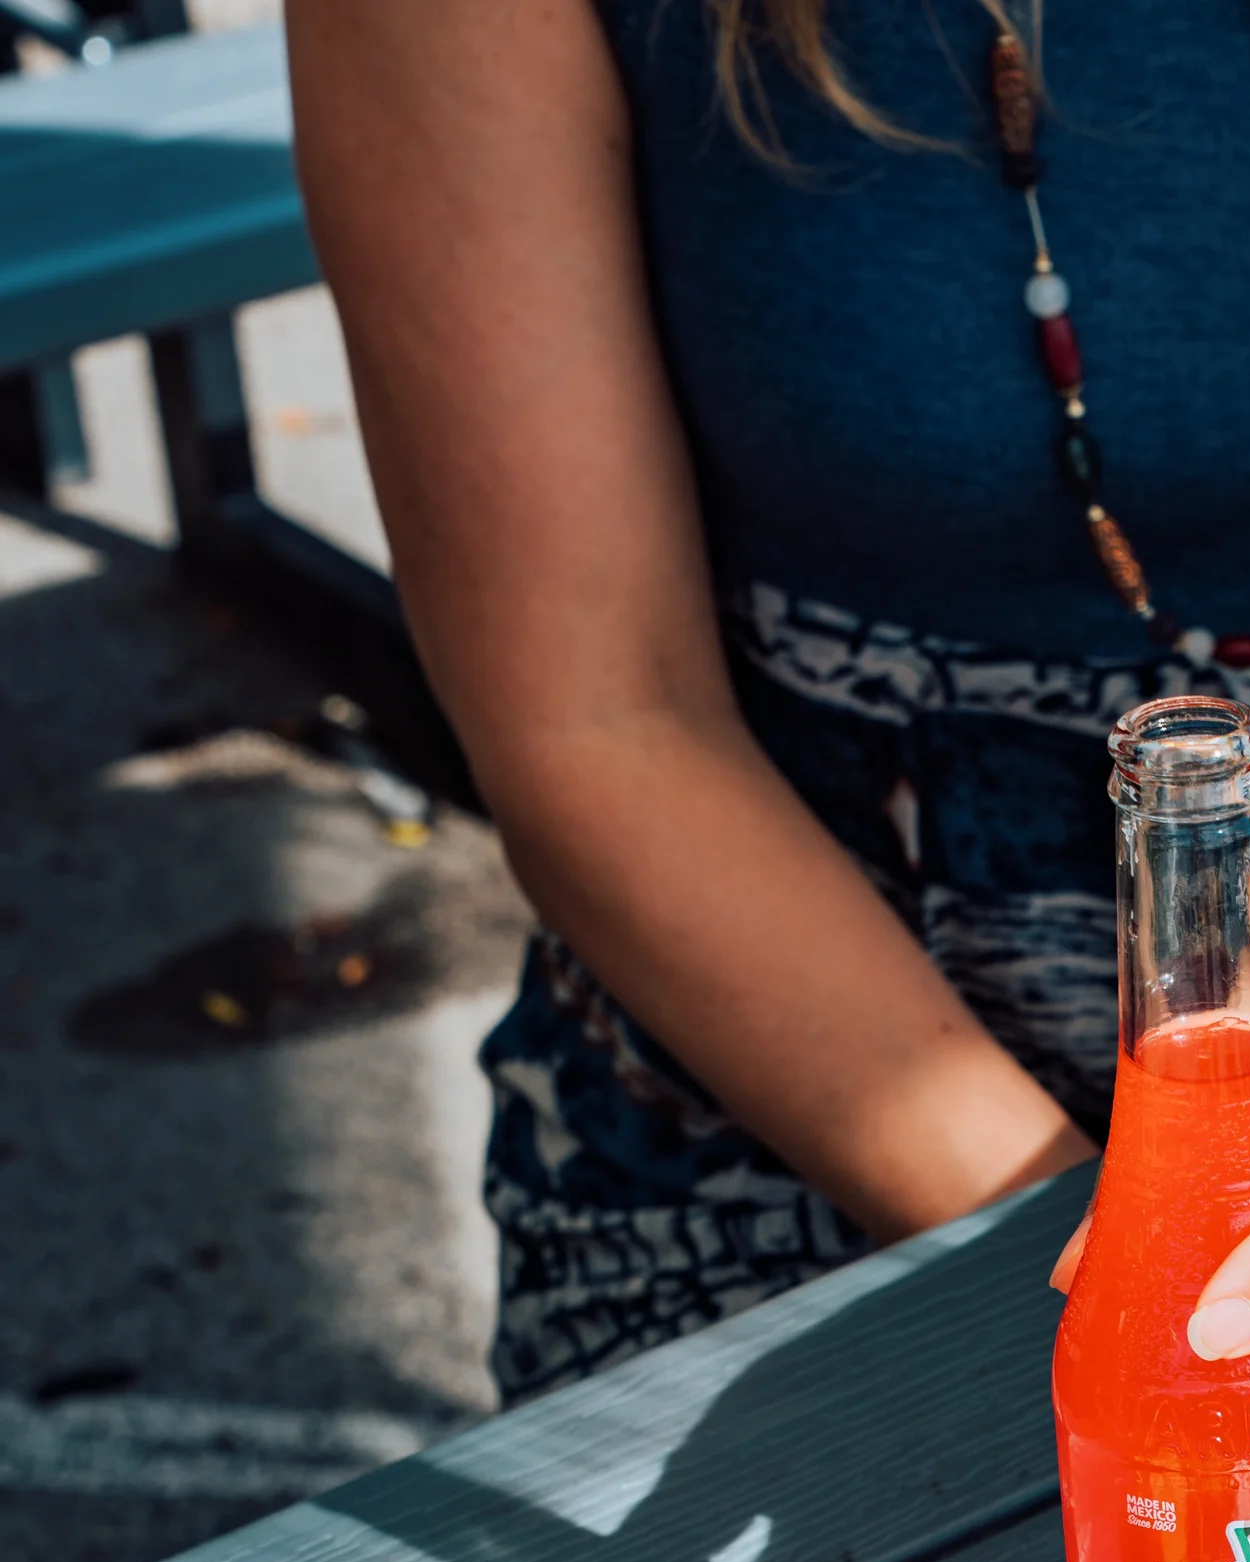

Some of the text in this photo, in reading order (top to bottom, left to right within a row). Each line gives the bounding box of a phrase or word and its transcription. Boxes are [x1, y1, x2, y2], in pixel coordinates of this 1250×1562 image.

[1126, 1493, 1175, 1512] MADE IN
[1127, 1503, 1177, 1522] MEXICO
[1127, 1514, 1177, 1533] Since 1950
